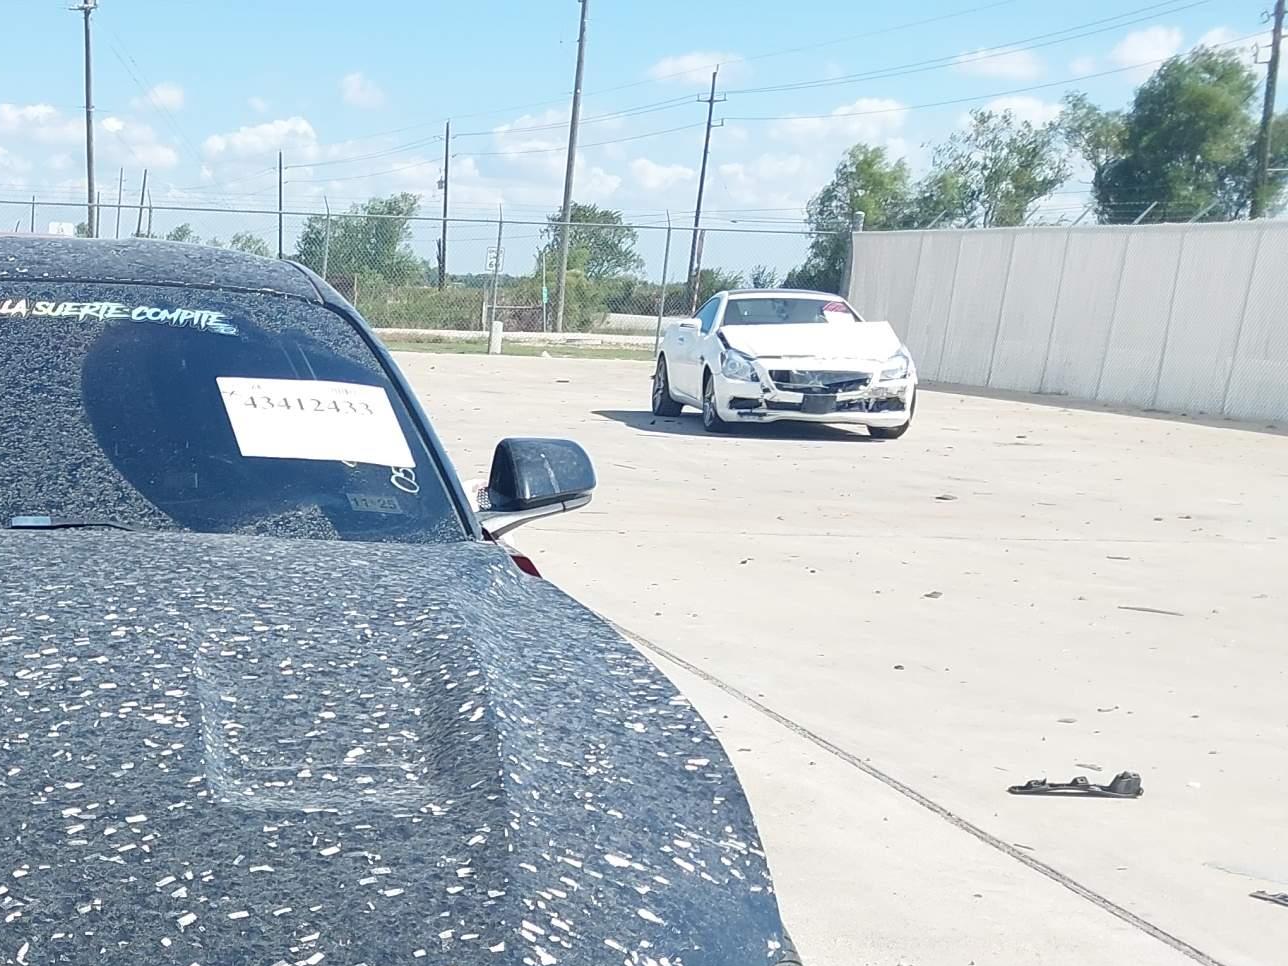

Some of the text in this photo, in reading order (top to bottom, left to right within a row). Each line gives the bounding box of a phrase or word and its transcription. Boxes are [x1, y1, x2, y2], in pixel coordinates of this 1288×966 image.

[0, 299, 31, 318] LA
[32, 301, 126, 321] SUERTE
[130, 304, 240, 336] COMPITE
[244, 396, 375, 416] 43412433
